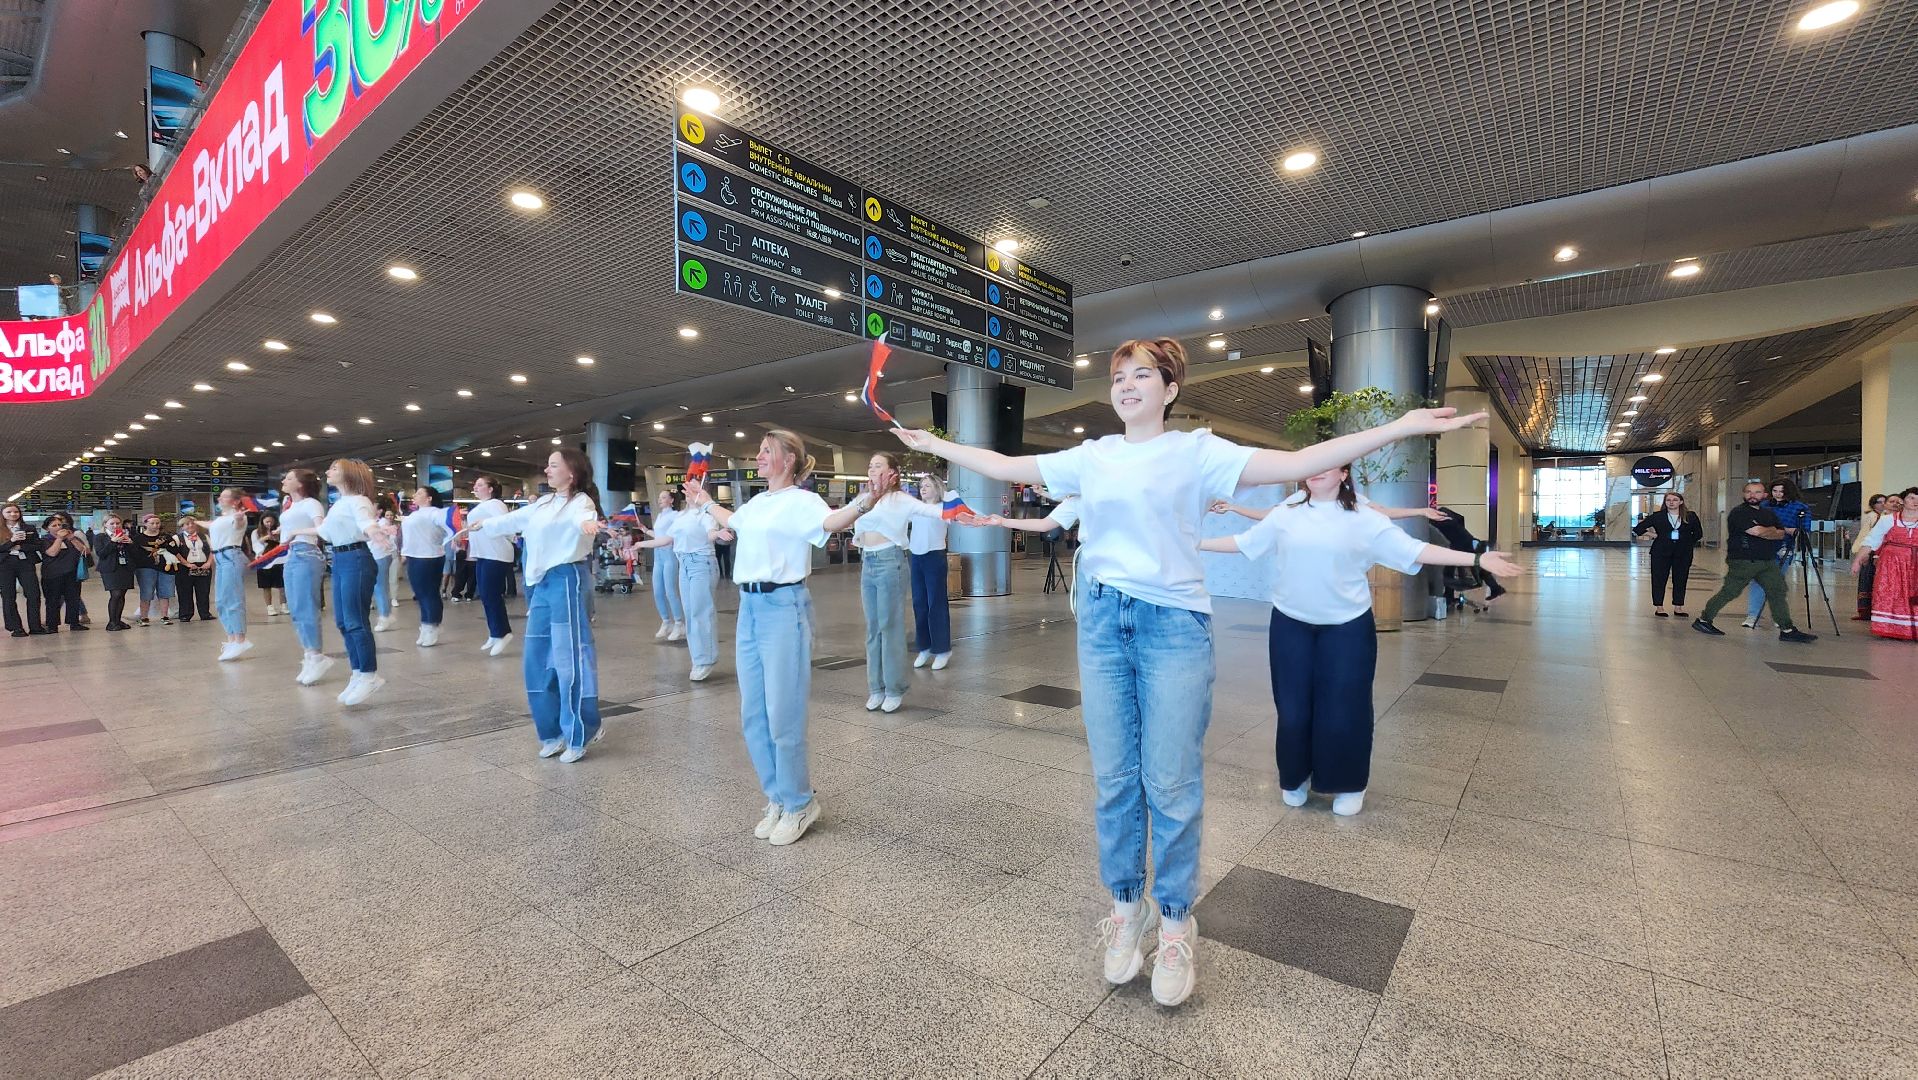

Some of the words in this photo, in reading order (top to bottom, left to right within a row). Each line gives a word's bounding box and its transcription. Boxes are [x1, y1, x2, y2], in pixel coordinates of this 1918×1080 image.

[749, 140, 773, 157] ВЫЛЕТ
[749, 151, 794, 176] ВНУТРЕННИЕ
[794, 172, 832, 194] АВИАЛИНИИ
[749, 162, 782, 182] DOMESTIC
[782, 176, 818, 198] DEPARTURES
[134, 60, 289, 316] Альфа-Вклад
[750, 186, 805, 214] ОБСЛУЖИВАНИЕ
[806, 209, 820, 221] ЛИЦ
[758, 199, 810, 226] ОГРАНИЧЕННОЙ
[810, 220, 860, 246] ПОДВИЖНОСТЬЮ
[766, 213, 800, 232] ASSISTANCE
[752, 236, 790, 258] АПТЕКА
[752, 253, 784, 269] PHARMACY
[794, 293, 828, 311] ТУАЛЕТ
[795, 308, 814, 319] TOILET
[912, 327, 936, 343] ВЫХОД
[936, 335, 940, 344] 3
